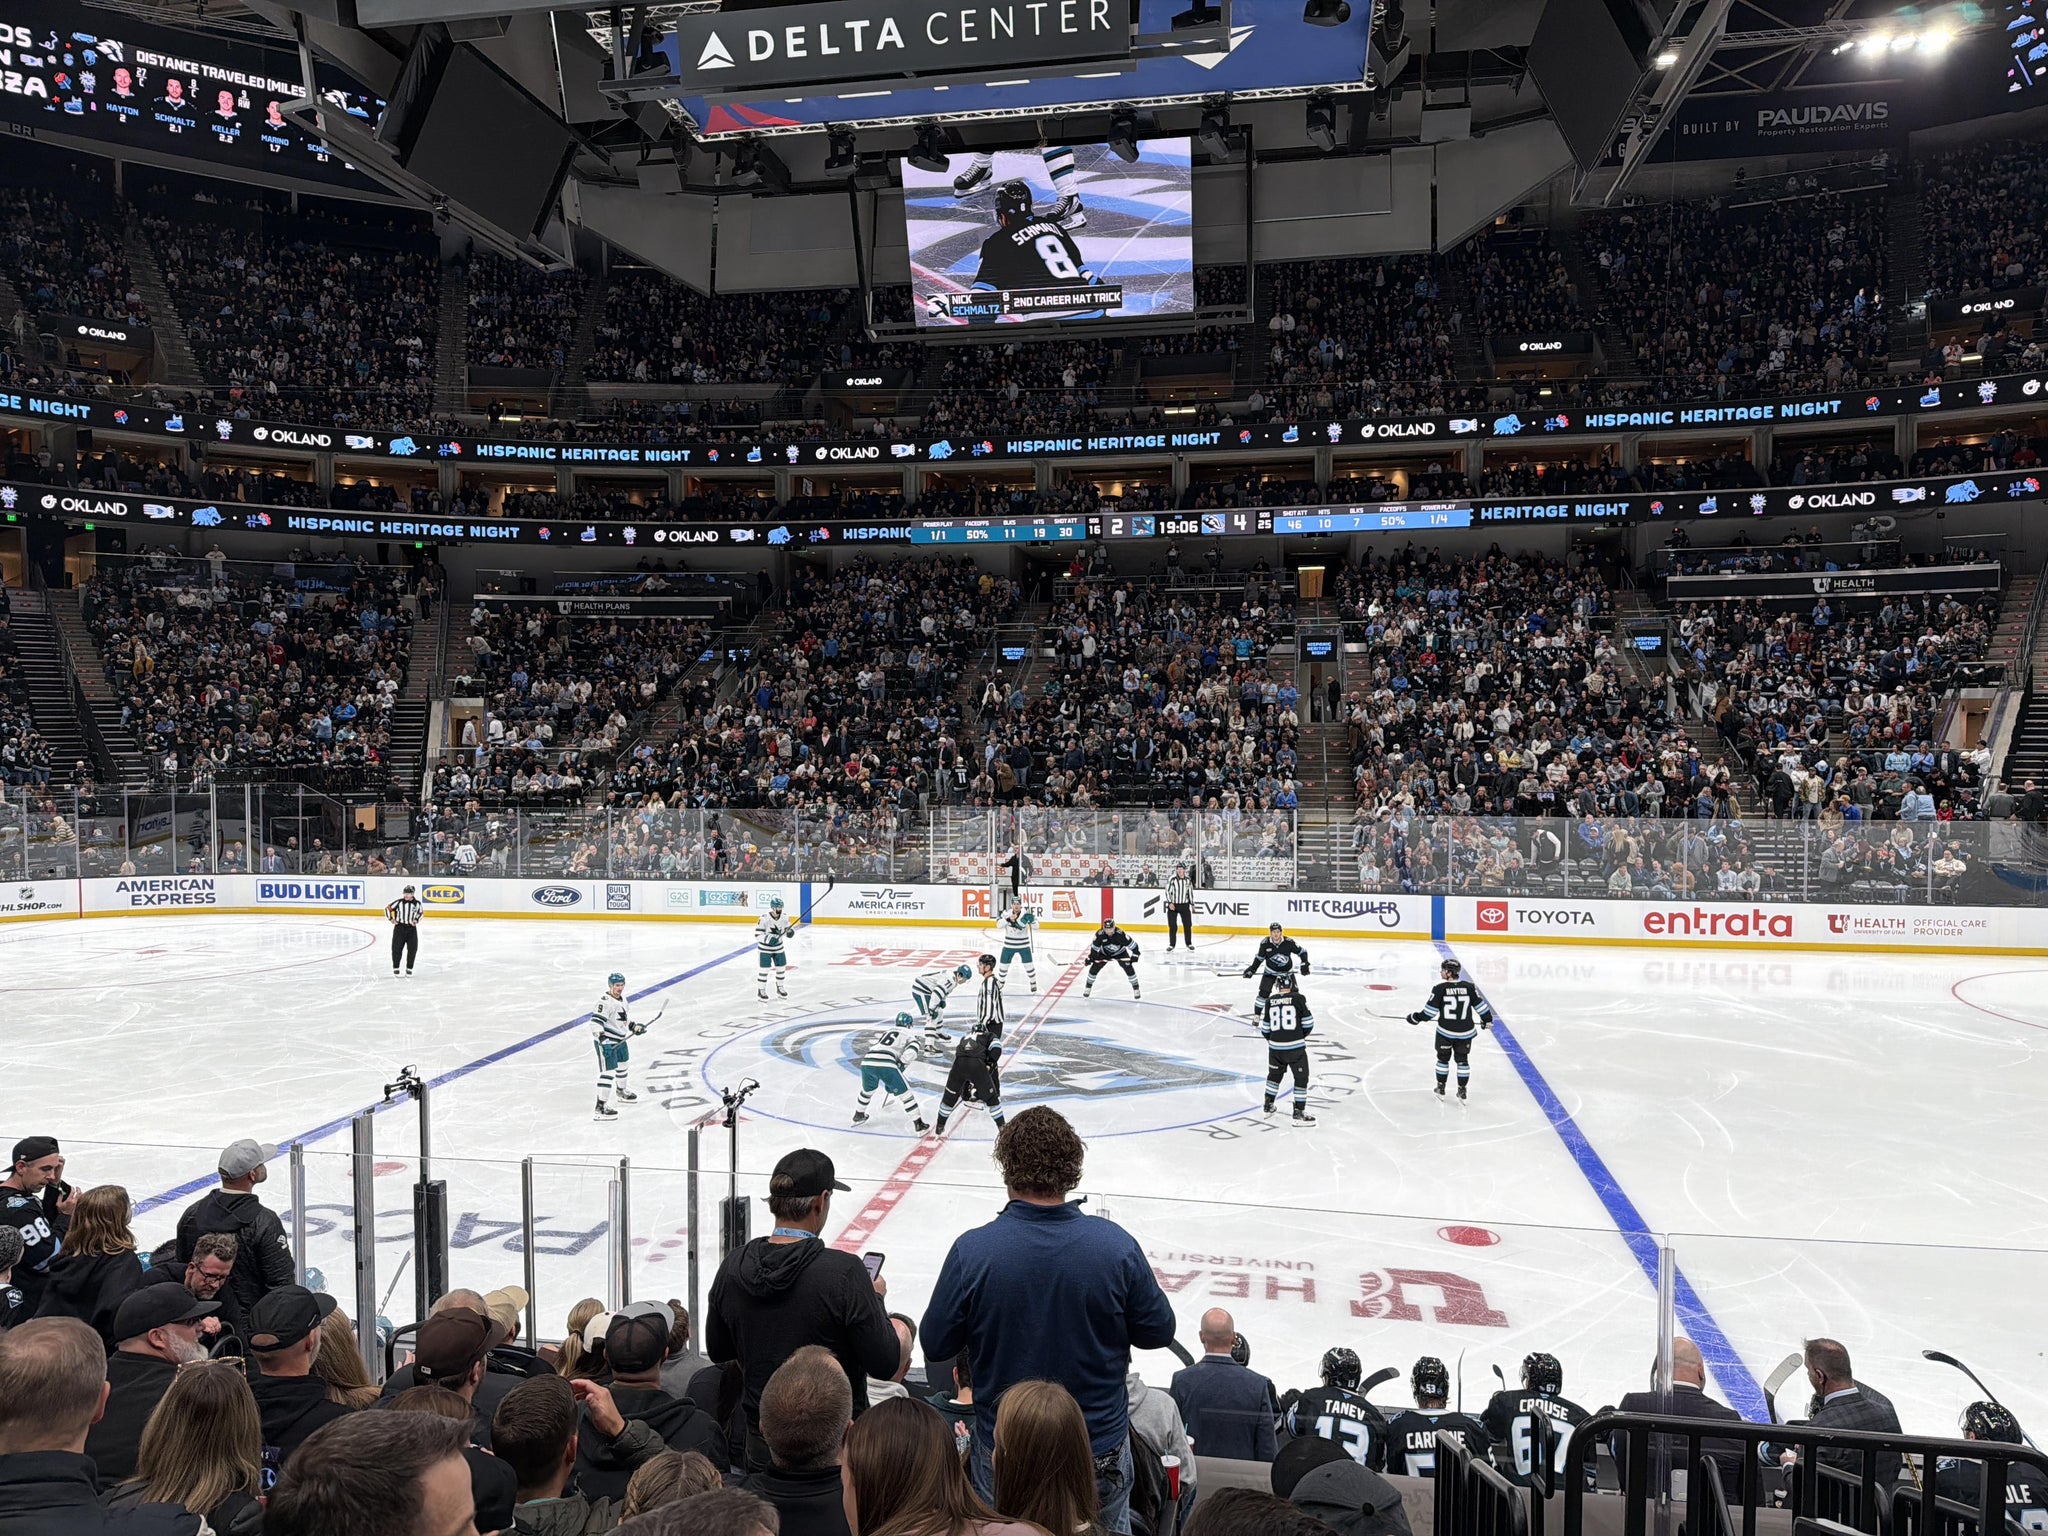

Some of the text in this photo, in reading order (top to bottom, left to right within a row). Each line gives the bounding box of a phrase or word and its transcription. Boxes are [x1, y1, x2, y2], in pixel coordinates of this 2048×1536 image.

[748, 0, 1111, 62] DELTA CENTER
[136, 67, 147, 77] 27
[136, 50, 306, 98] DISTANCE TRAVELED (MILES
[106, 103, 139, 116] HAYTON
[238, 99, 250, 109] RW
[119, 114, 127, 123] 2
[154, 113, 196, 128] SCHMALTZ
[169, 125, 182, 133] 2.1
[212, 124, 240, 137] KELLER
[1683, 122, 1717, 135] BUILT
[1725, 120, 1740, 132] BY
[1758, 122, 1889, 137] Property Restoration Experts
[219, 134, 234, 144] 2.2
[261, 134, 289, 147] MARINO
[270, 143, 281, 152] 1.7
[317, 153, 328, 162] 2.1
[1035, 235, 1081, 279] 8
[952, 294, 972, 306] NICK
[1003, 292, 1010, 302] 8
[1013, 292, 1121, 308] 2ND CAREER HAT TRICK
[953, 304, 1000, 316] SCHMALTZ
[1004, 305, 1010, 315] F
[89, 327, 126, 341] OKLAND
[1529, 341, 1562, 351] OKLAND
[854, 377, 882, 386] OKLAND
[29, 398, 91, 419] NIGHT
[1585, 400, 1841, 428] HISPANIC HERITAGE NIGHT
[1378, 422, 1435, 437] OKLAND
[272, 430, 331, 447] OKLAND
[1007, 431, 1221, 453] HISPANIC HERITAGE NIGHT
[477, 444, 691, 463] HISPANIC HERITAGE NIGHT
[830, 447, 879, 459] OKLAND
[61, 497, 128, 515] OKLAND
[1808, 492, 1875, 508] OKLAND
[1481, 502, 1630, 519] HERITAGE NIGHT
[1233, 514, 1247, 530] 4
[1258, 519, 1272, 530] 25
[1287, 520, 1302, 529] 46
[1318, 519, 1331, 528] 10
[1353, 518, 1360, 527] 7
[1381, 516, 1406, 526] 50%
[1430, 514, 1448, 525] 1/4
[288, 516, 520, 539] HISPANIC HERITAGE NIGHT
[1059, 527, 1073, 537] 30
[1089, 525, 1100, 535] 16
[1111, 518, 1123, 535] 2
[1159, 520, 1198, 534] 19:06
[669, 530, 719, 543] OKLAND
[930, 530, 946, 541] 1/1
[966, 529, 988, 540] 50%
[1004, 529, 1016, 538] 11
[1034, 528, 1046, 538] 19
[1834, 579, 1874, 588] HEALTH
[574, 602, 604, 610] HEALTH
[115, 879, 215, 893] AMERICAN
[260, 884, 361, 900] BUD LIGHT
[609, 886, 628, 894] BUILT
[131, 892, 216, 906] EXPRESS
[425, 887, 462, 901] IKEA
[540, 887, 574, 906] Ford
[670, 892, 689, 900] G2G
[709, 893, 728, 901] G2G
[848, 901, 926, 910] AMERICA FIRST
[968, 906, 979, 918] fit
[1287, 899, 1401, 928] NITECRAWLER
[1516, 909, 1595, 925] TOYOTA
[1644, 907, 1792, 937] entrata
[1854, 918, 1906, 930] HEALTH
[1913, 919, 1987, 928] OFFICIAL CARE
[1913, 928, 1963, 936] PROVIDER
[843, 946, 984, 958] GEEK
[828, 957, 975, 968] SEAT
[944, 980, 953, 989] 71
[1443, 995, 1470, 1020] 27
[697, 995, 881, 1039] CENTER
[1269, 1005, 1296, 1031] 88
[646, 1047, 711, 1111] DELTA
[20, 1217, 51, 1246] 98
[1425, 1384, 1436, 1394] 53
[1546, 1384, 1555, 1392] 67
[1325, 1399, 1366, 1421] TANEV
[1519, 1398, 1569, 1421] CROUSE
[1511, 1415, 1576, 1476] 67
